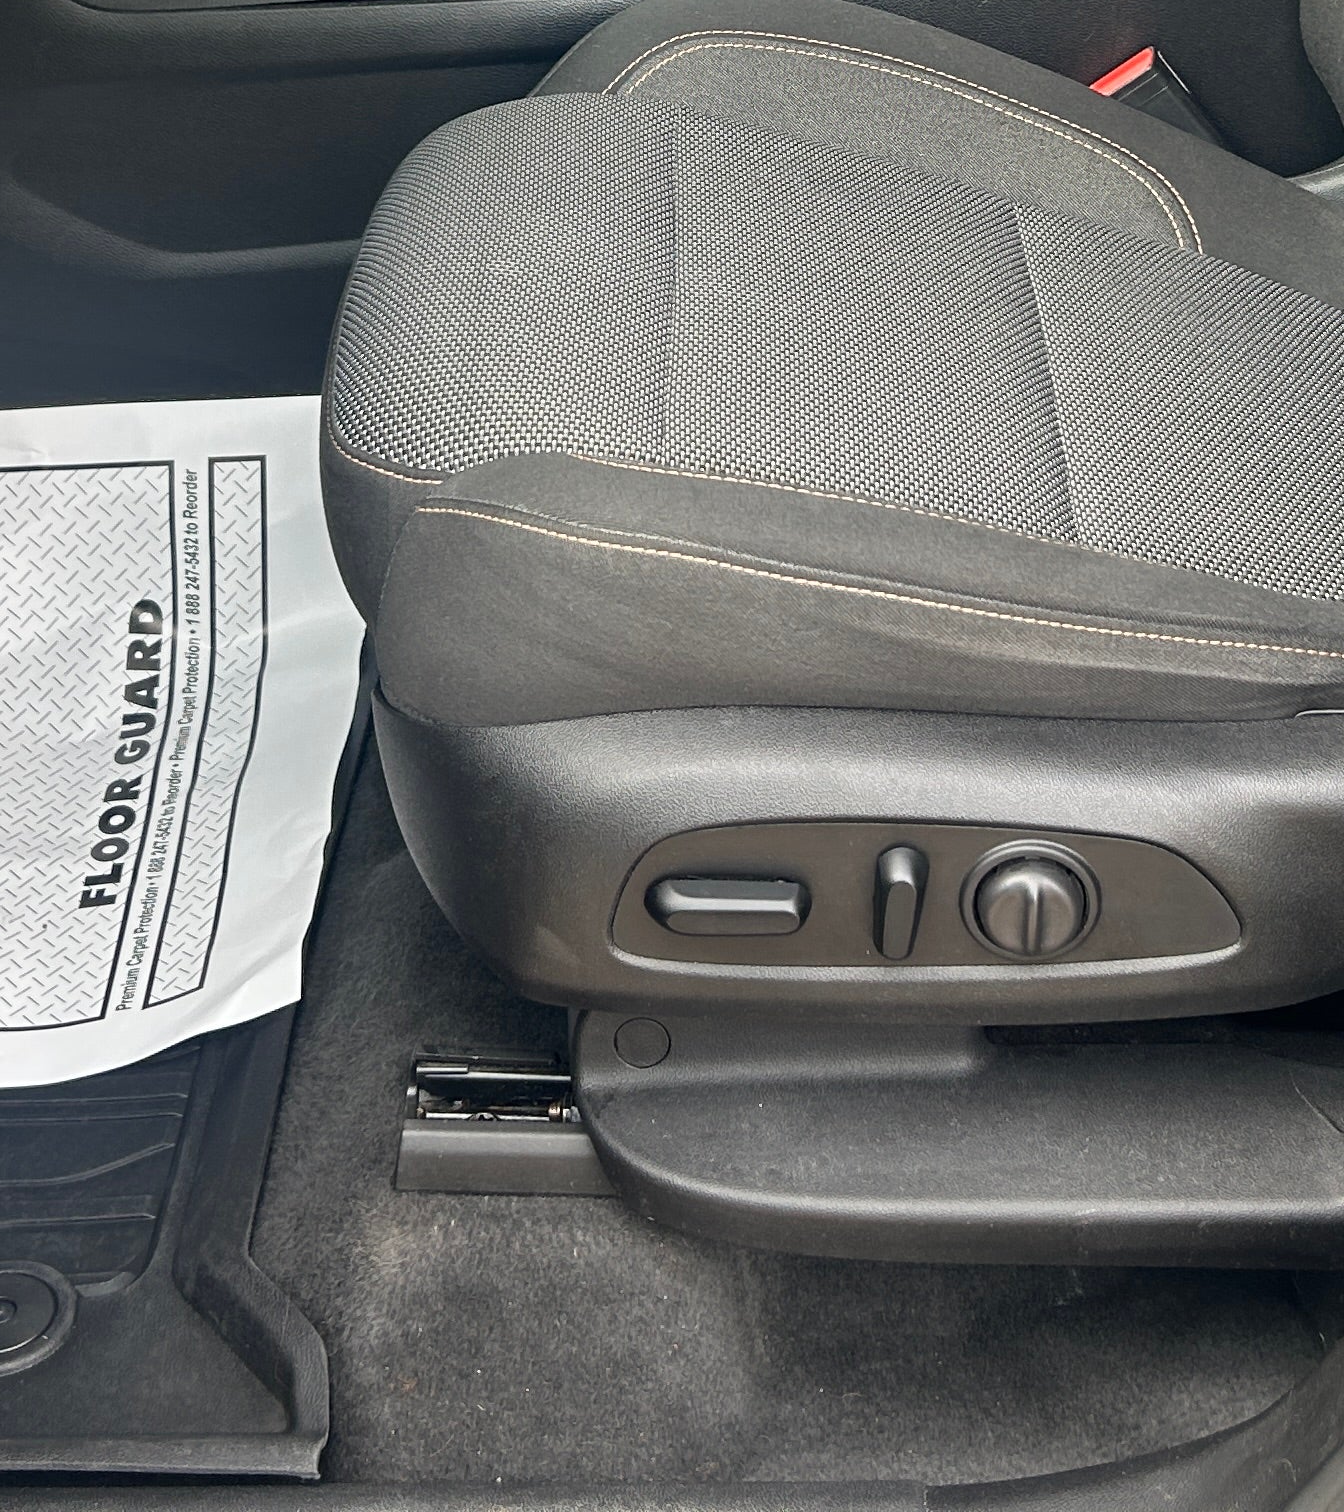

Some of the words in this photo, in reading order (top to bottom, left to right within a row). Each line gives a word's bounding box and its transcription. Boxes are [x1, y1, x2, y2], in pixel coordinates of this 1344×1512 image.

[182, 469, 198, 520] Reorder
[184, 523, 198, 536] to
[183, 539, 200, 591] 247-5432
[184, 594, 201, 615] 888
[185, 617, 201, 626] 1
[182, 639, 201, 694] Protection
[177, 697, 198, 725] Carpet
[78, 775, 143, 909] FLOOR
[114, 599, 163, 765] GUARD
[169, 726, 191, 761] Premium
[162, 768, 183, 806] Reorder
[163, 804, 175, 816] to
[152, 817, 174, 856] 247-5432
[133, 886, 159, 935] Protection
[126, 935, 150, 967] Carpet
[115, 968, 140, 1011] Premium
